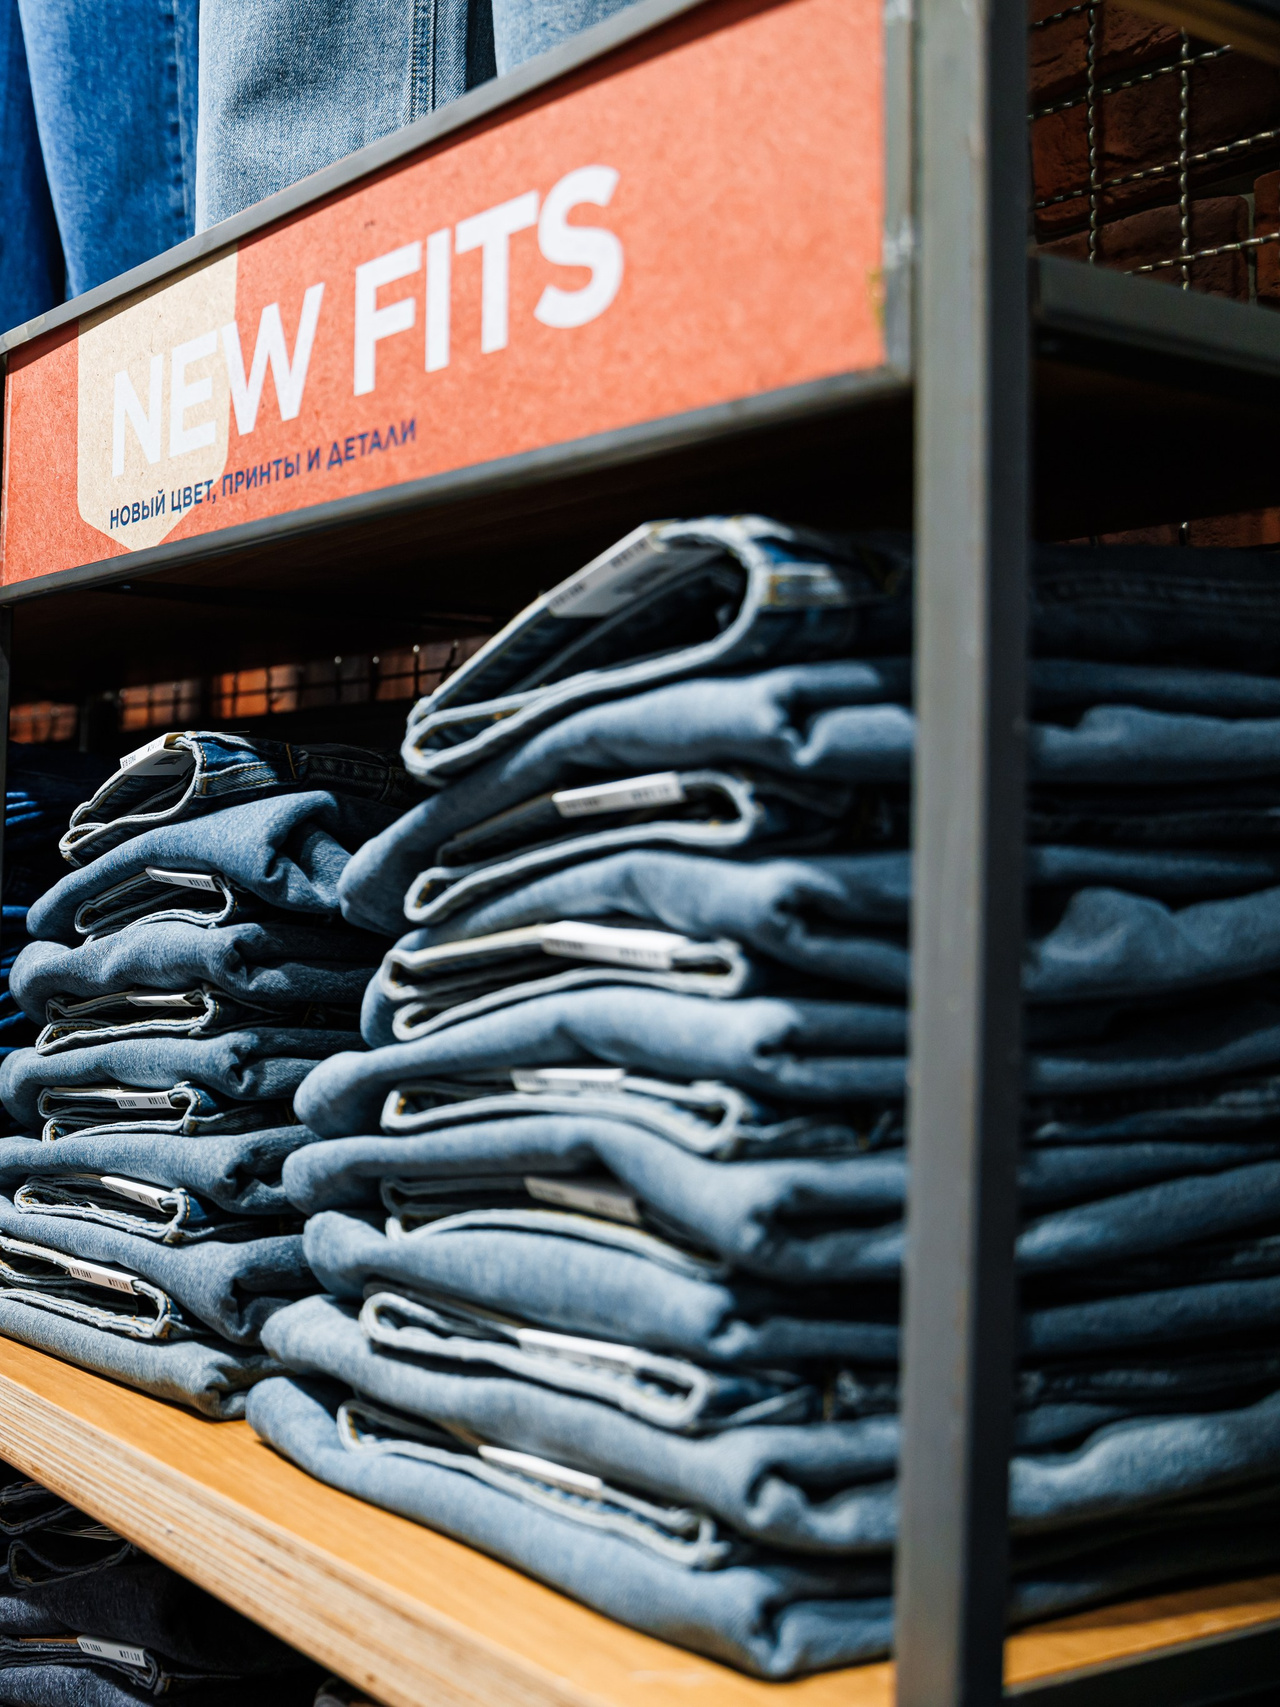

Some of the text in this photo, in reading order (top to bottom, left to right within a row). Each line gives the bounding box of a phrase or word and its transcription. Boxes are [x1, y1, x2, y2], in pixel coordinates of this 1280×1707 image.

[112, 164, 623, 477] NEW FITS
[110, 418, 417, 529] НОВЫЙ ЦВЕТ, ПРИНТЫ И ДЕТАЛИ
